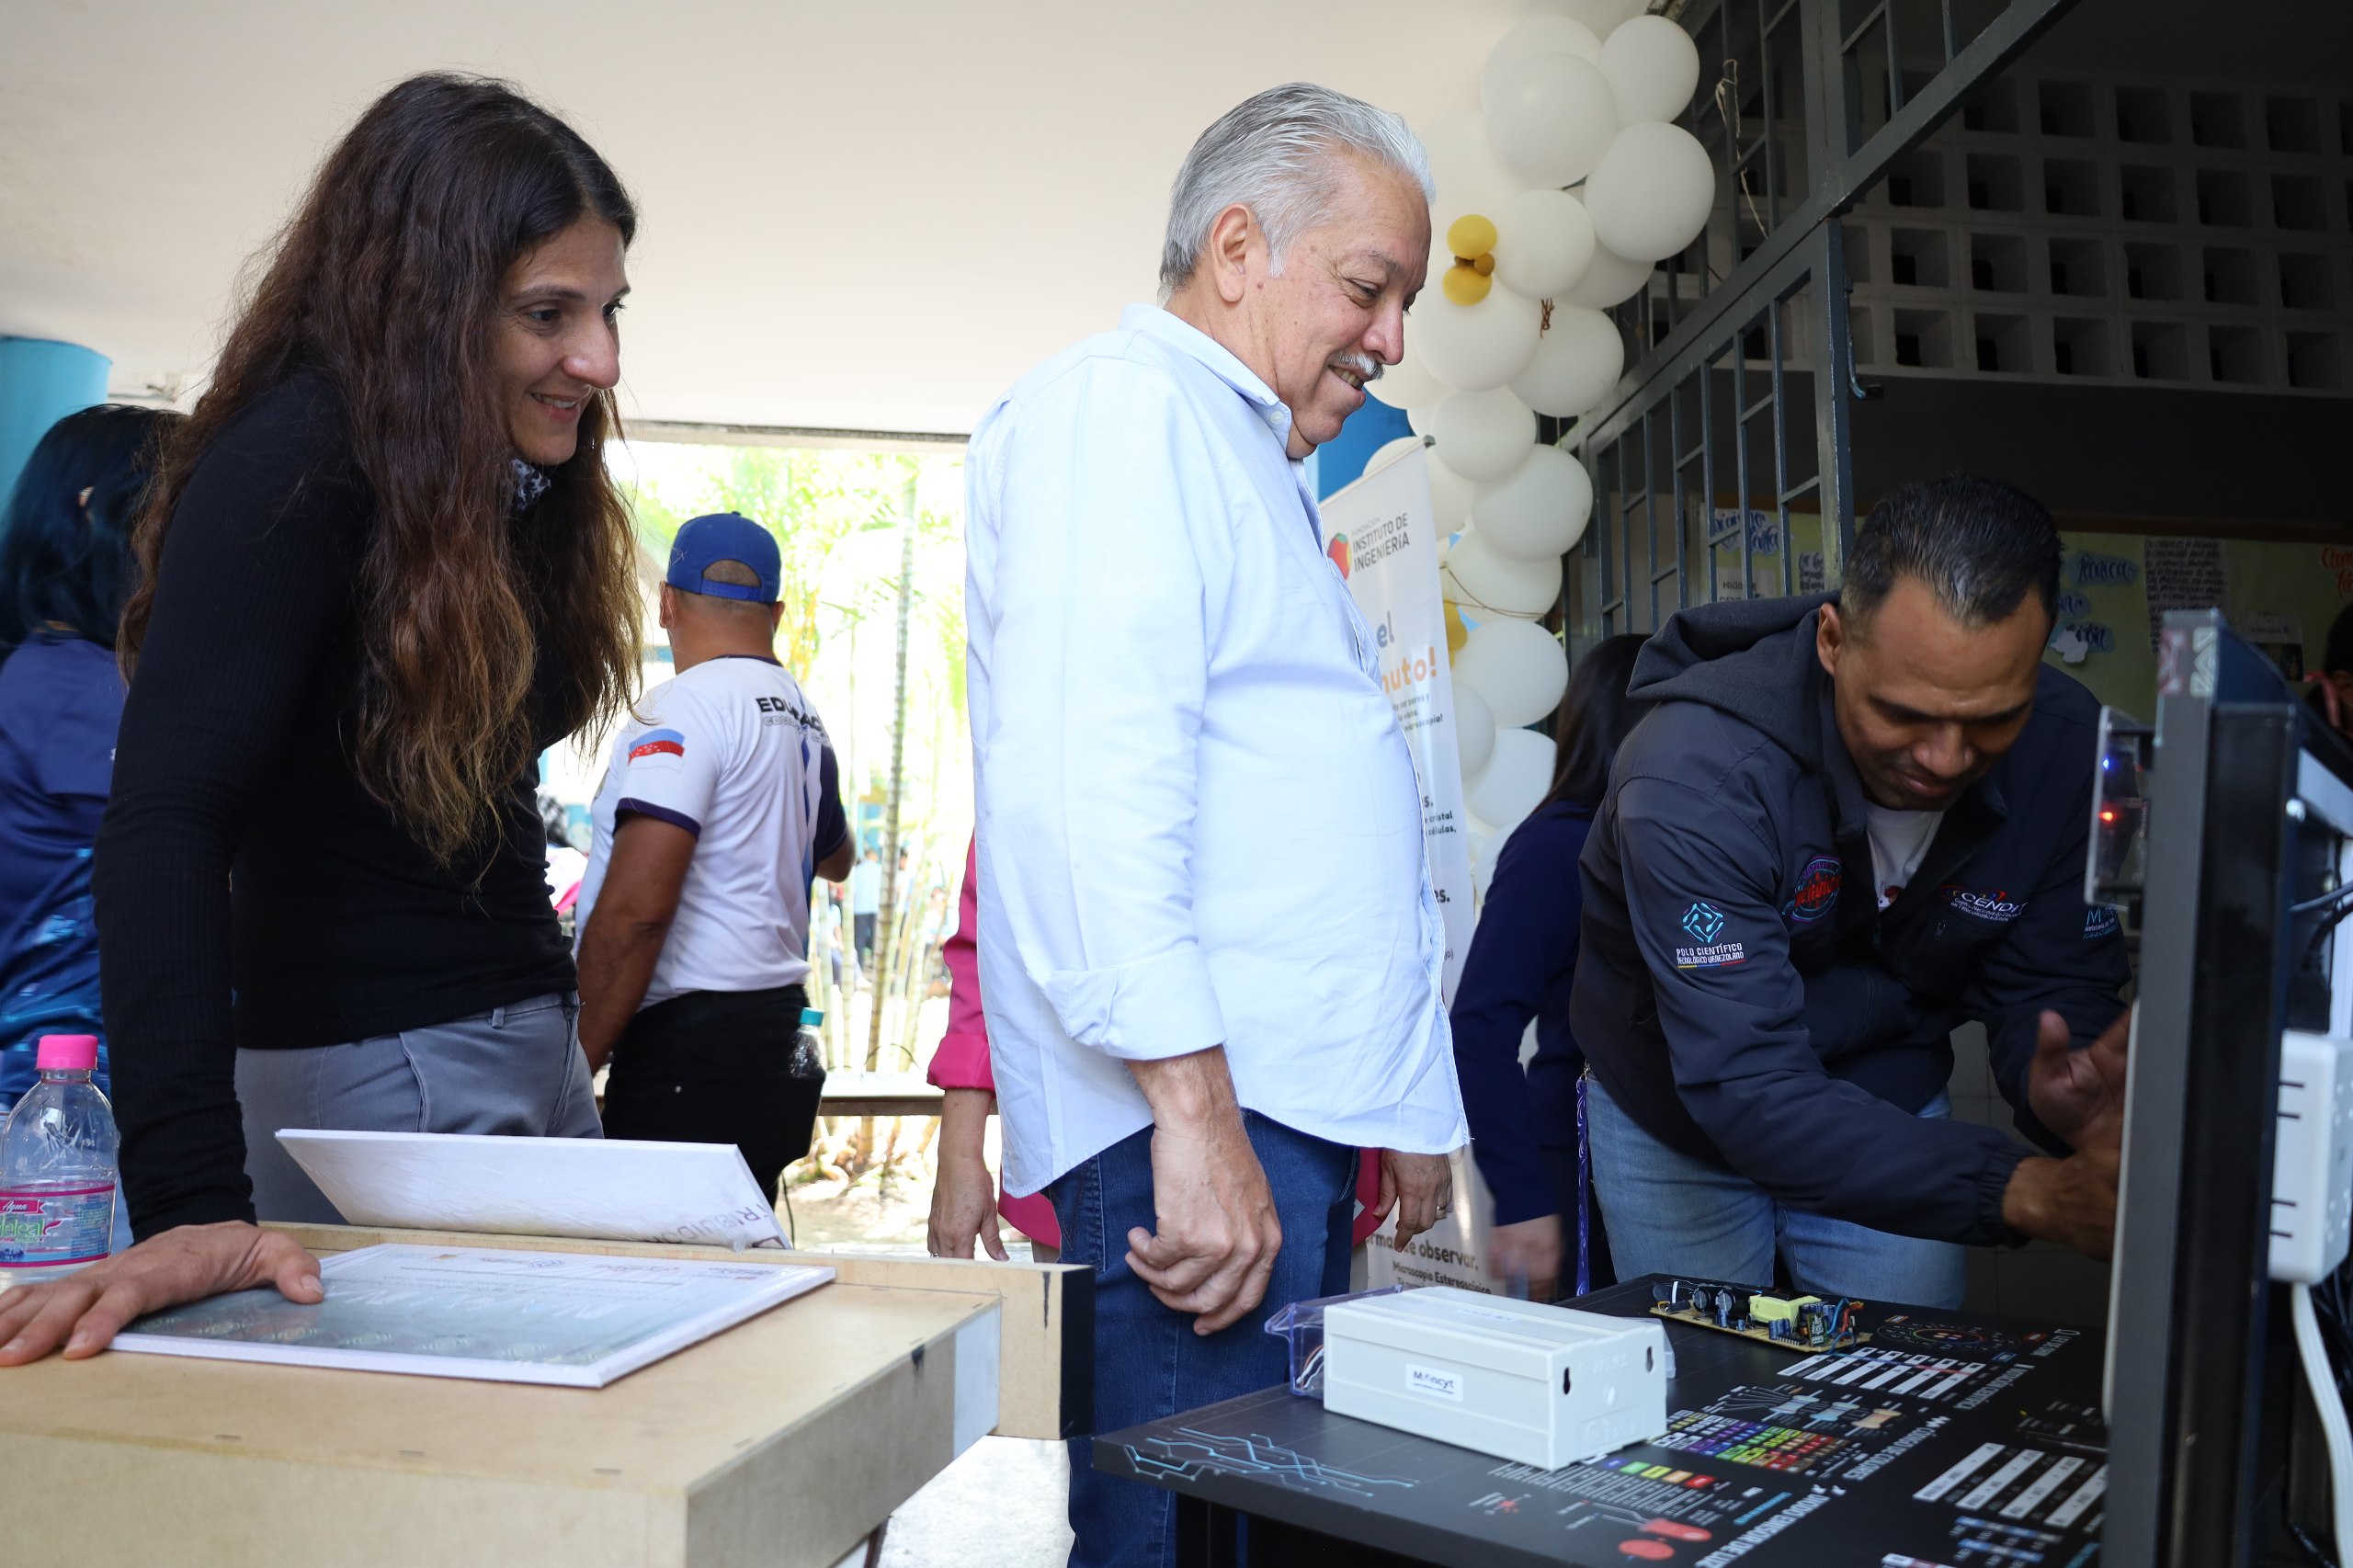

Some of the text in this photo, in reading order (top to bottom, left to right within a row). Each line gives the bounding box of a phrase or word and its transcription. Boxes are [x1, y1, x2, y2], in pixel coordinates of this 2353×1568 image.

[1352, 512, 1408, 553] INSTITUTO DE
[1676, 942, 1743, 956] POLO CIENTÍFICO
[1707, 951, 1745, 964] VENEZOLANO
[2, 1200, 28, 1213] Agua
[1419, 1239, 1478, 1271] observar.
